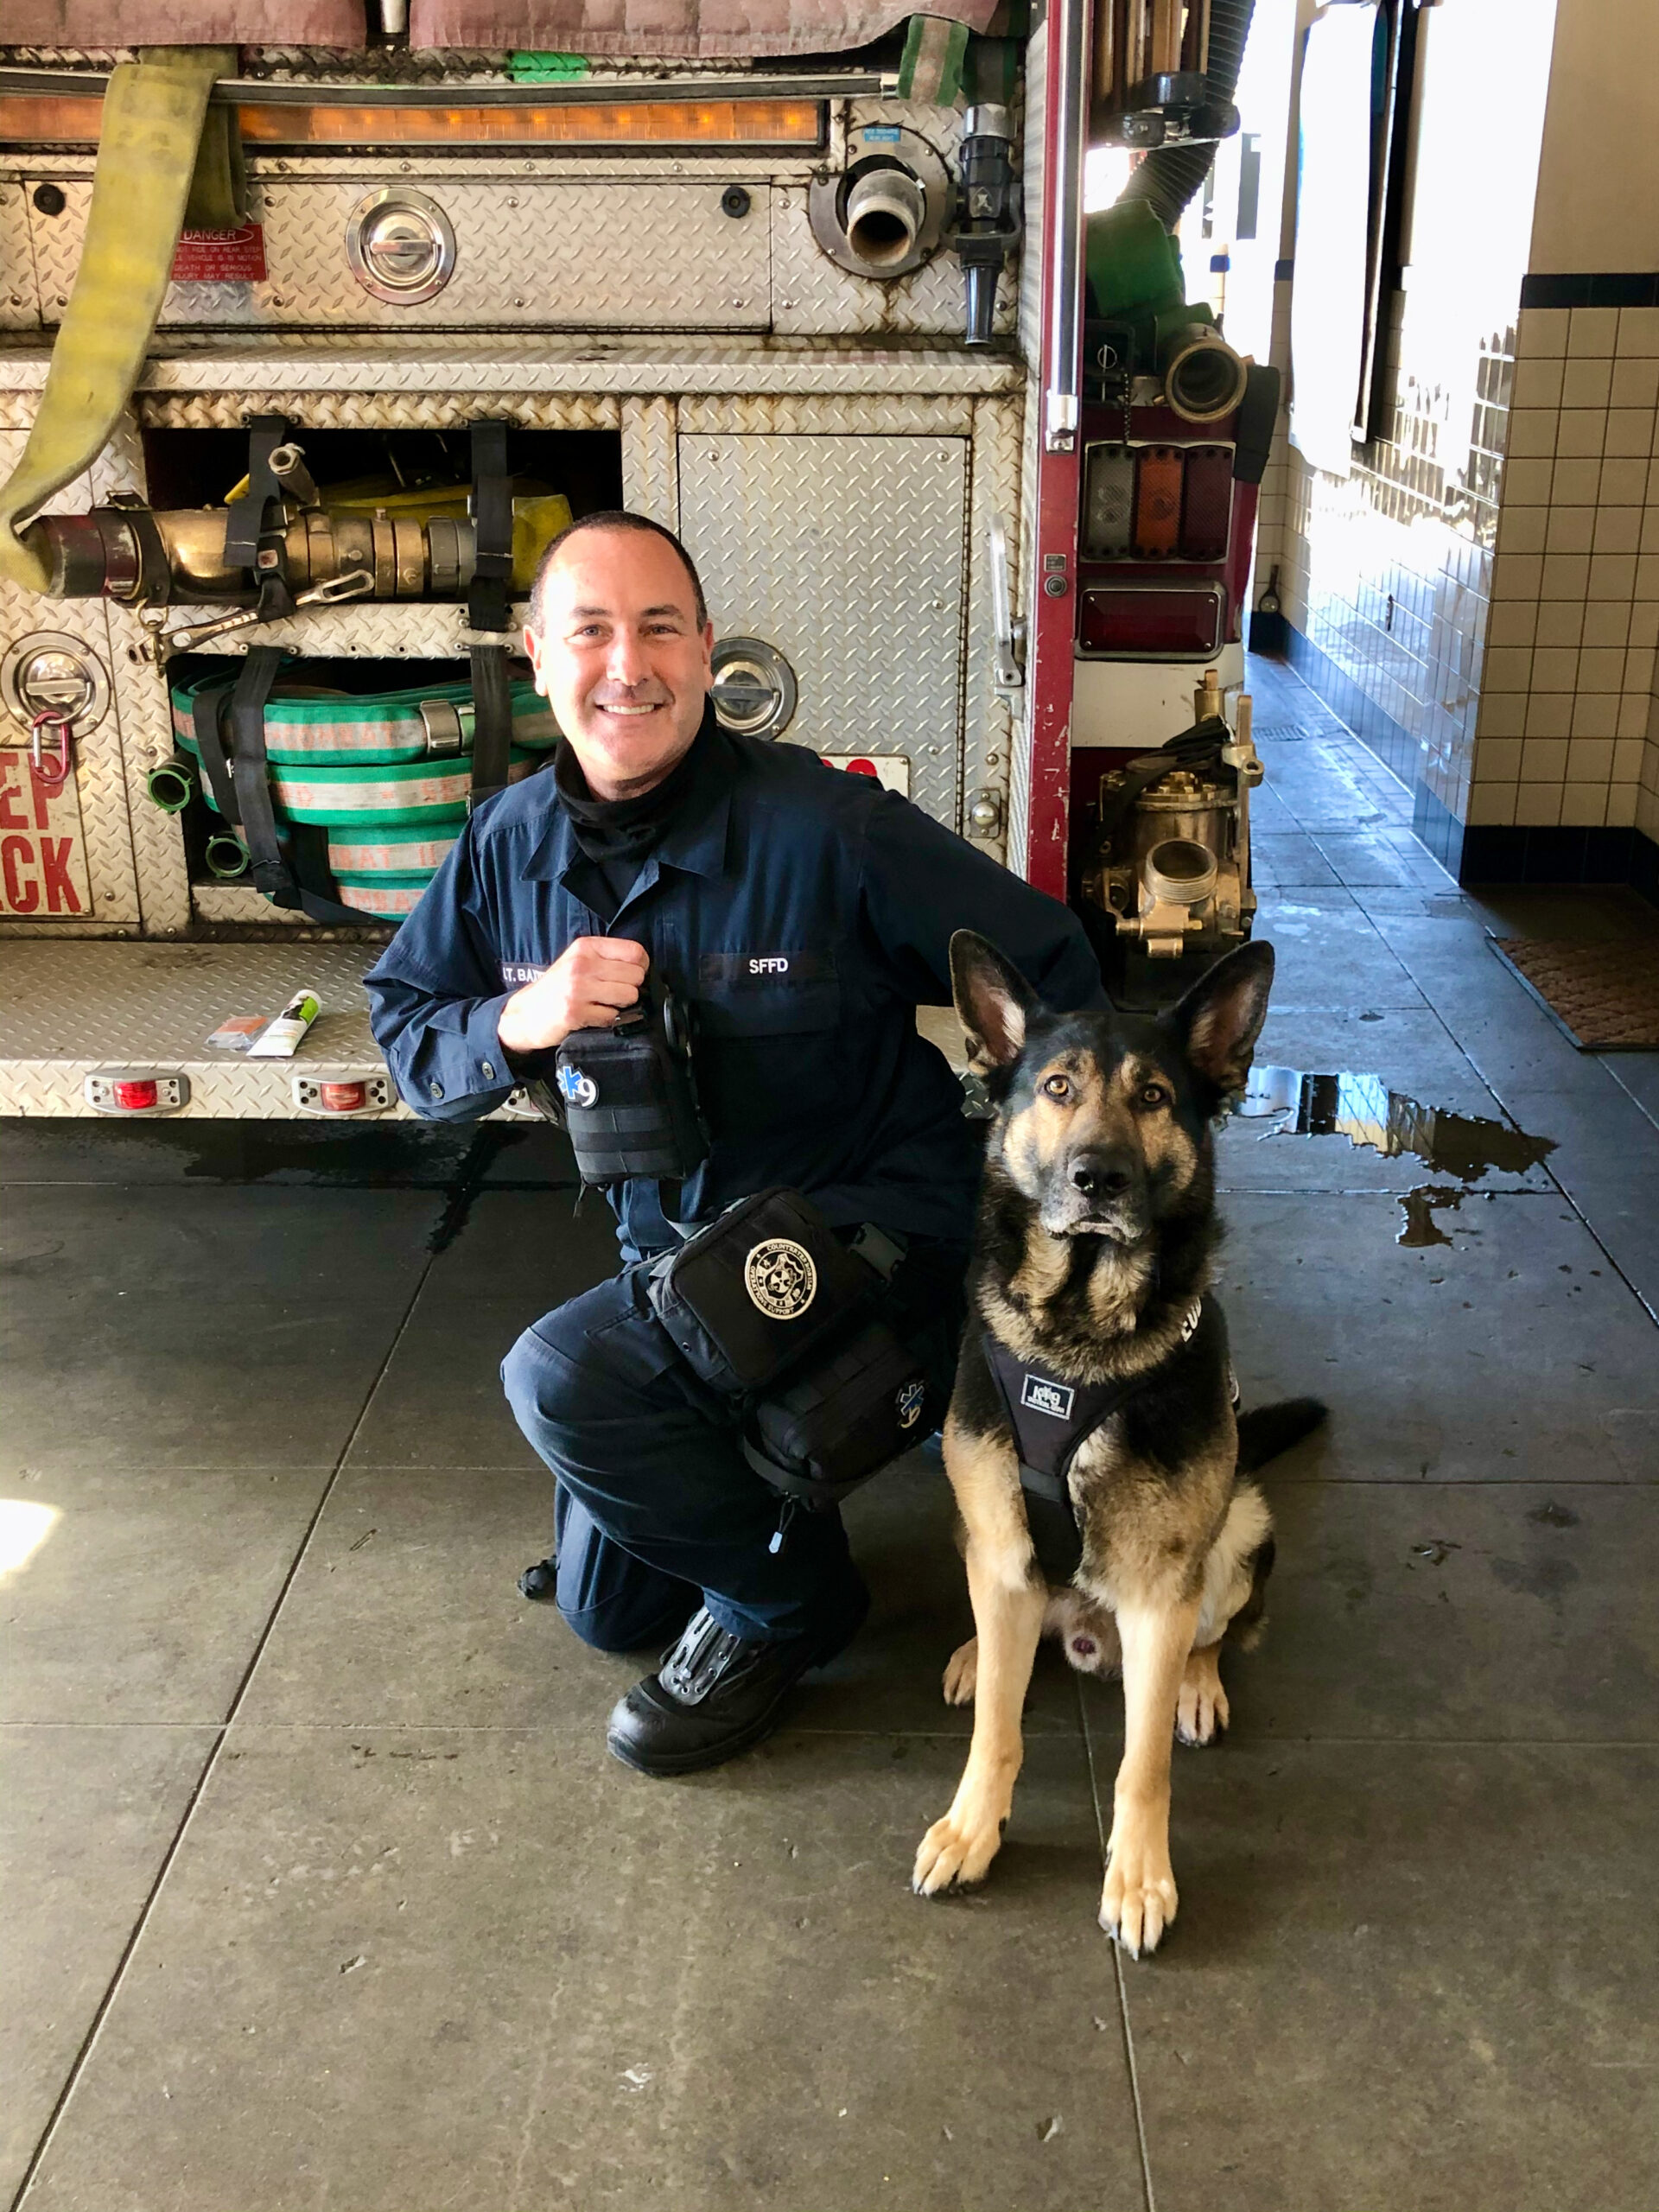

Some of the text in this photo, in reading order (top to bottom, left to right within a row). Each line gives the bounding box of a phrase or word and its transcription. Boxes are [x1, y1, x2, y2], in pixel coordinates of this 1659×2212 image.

[183, 228, 236, 241] DANGER
[0, 835, 81, 913] CK
[748, 957, 789, 975] SFFD
